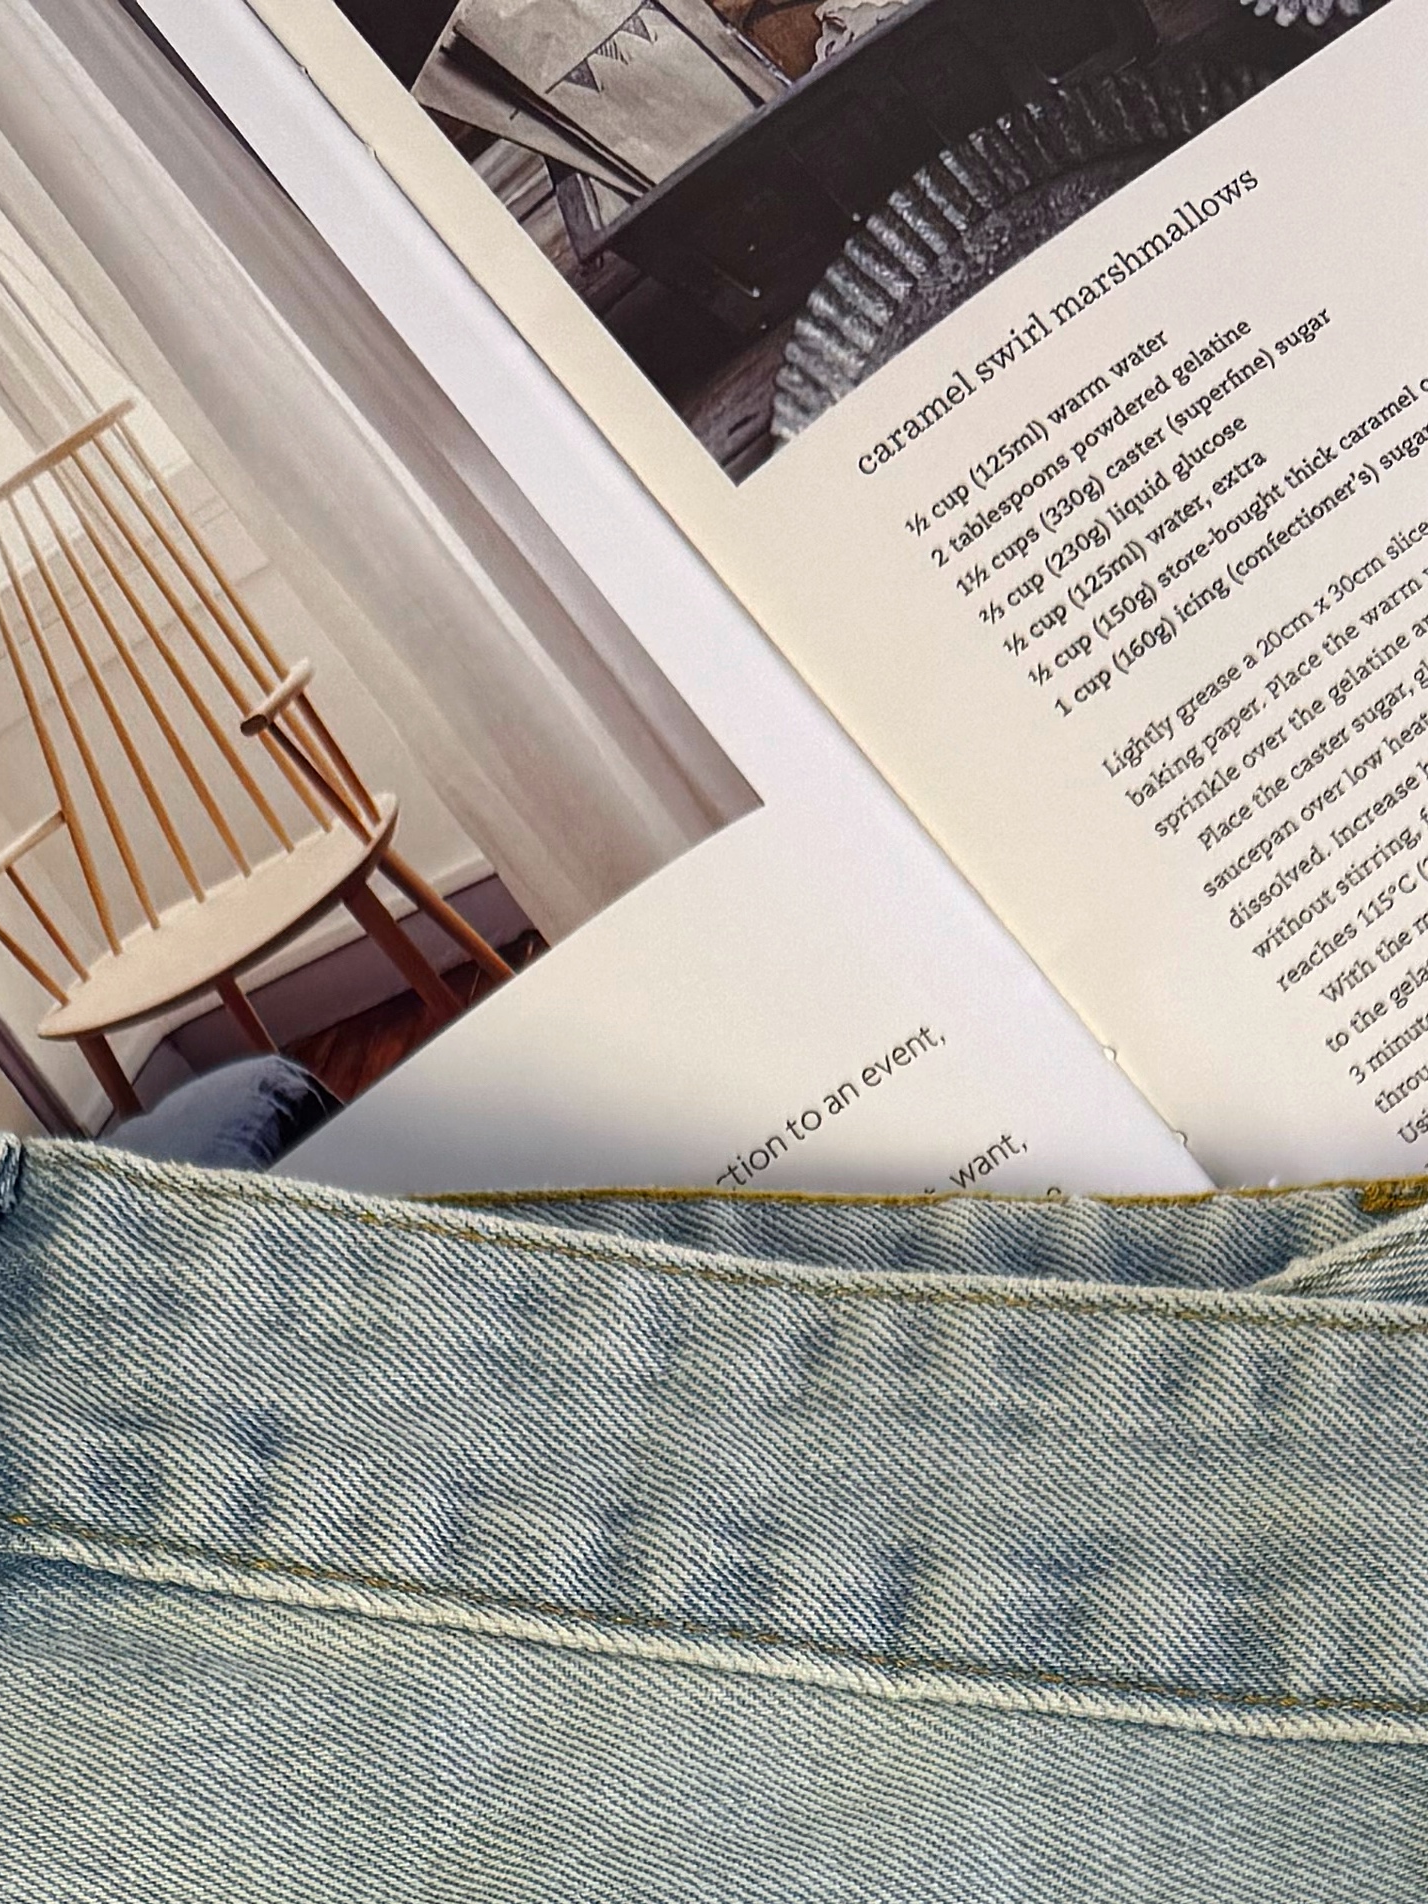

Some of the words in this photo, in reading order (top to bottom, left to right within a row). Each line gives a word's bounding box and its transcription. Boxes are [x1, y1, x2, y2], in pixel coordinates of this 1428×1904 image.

[856, 367, 978, 476] caramel
[973, 310, 1054, 385] swirl
[1047, 168, 1259, 327] marshmallows
[930, 481, 970, 519] cup
[967, 417, 1050, 491] (125ml)
[1045, 374, 1112, 425] warm
[1106, 328, 1169, 378] water
[929, 544, 950, 569] 2
[947, 451, 1071, 554] tablespoons
[1068, 372, 1172, 464] powdered
[1170, 319, 1252, 387] gelatine
[989, 523, 1041, 571] cups
[1037, 472, 1106, 534] (330g)
[1104, 425, 1167, 480] caster
[1164, 346, 1276, 437] (superfine)
[1273, 306, 1331, 356] sugar
[1005, 570, 1045, 607] cup
[1043, 516, 1112, 579] (230g)
[1103, 468, 1172, 527] liquid
[1170, 415, 1248, 483] glucose
[1027, 601, 1068, 639] cup
[1065, 537, 1148, 611] (125ml)
[1143, 492, 1213, 546] water,
[1210, 450, 1268, 496] extra
[1052, 631, 1093, 669] cup
[1090, 578, 1158, 641] (150g)
[1155, 482, 1286, 589] store-bought
[1282, 444, 1339, 490] thick
[1337, 383, 1420, 451] caramel
[1053, 695, 1073, 718] 1
[1072, 666, 1112, 704] cup
[1110, 613, 1178, 676] (160g)
[1171, 575, 1231, 624] icing
[1224, 460, 1381, 586] (confectioner's)
[1123, 742, 1206, 808] baking
[1199, 695, 1268, 757] paper.
[1263, 651, 1323, 701] Place
[1320, 622, 1361, 657] the
[1357, 575, 1424, 626] warm
[1153, 763, 1241, 838] sprinkle
[1240, 723, 1288, 769] over
[1286, 697, 1327, 732] the
[1326, 632, 1411, 707] gelatine
[786, 1110, 822, 1141] to
[823, 1082, 860, 1115] an
[861, 1026, 947, 1087] event,
[950, 1133, 1028, 1190] want,
